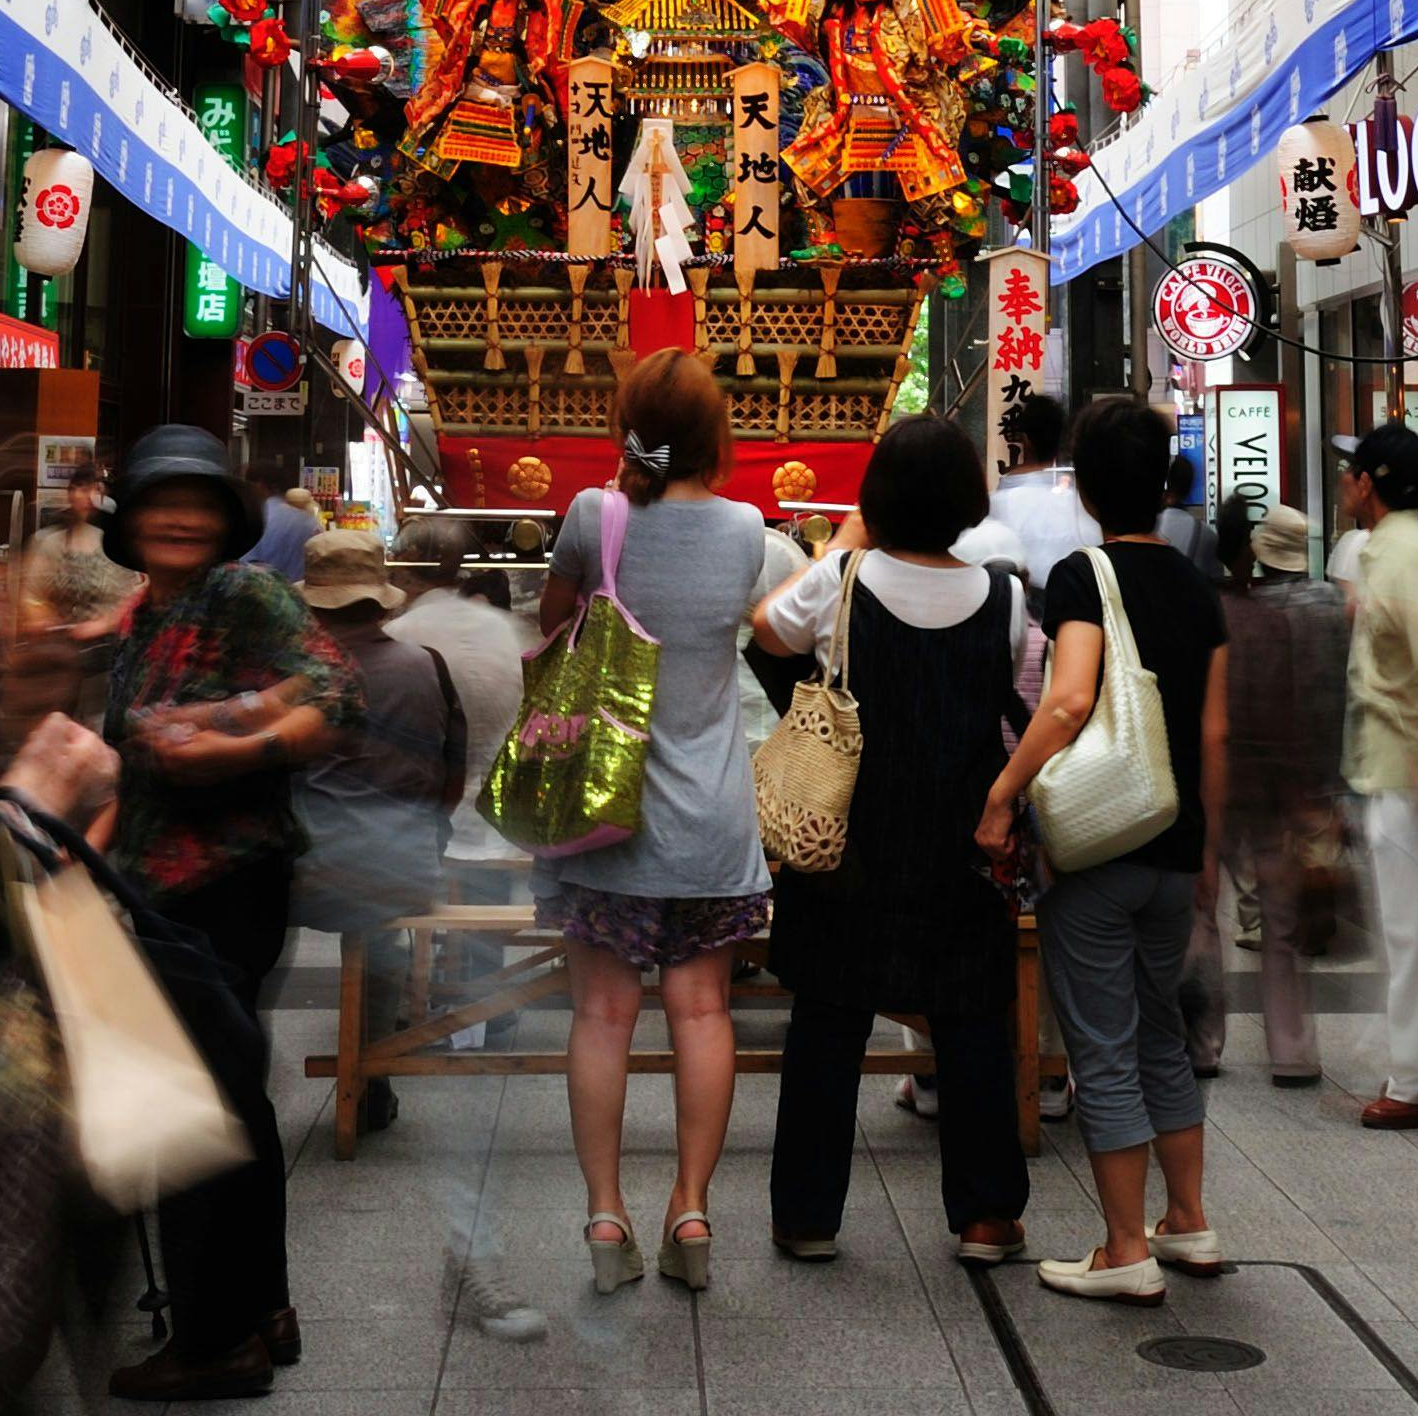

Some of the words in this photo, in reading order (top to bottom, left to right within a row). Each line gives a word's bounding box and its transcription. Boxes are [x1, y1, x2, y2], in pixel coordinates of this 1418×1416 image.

[569, 81, 614, 213] 天地人
[736, 91, 777, 240] 天地人
[247, 397, 300, 411] ここまで
